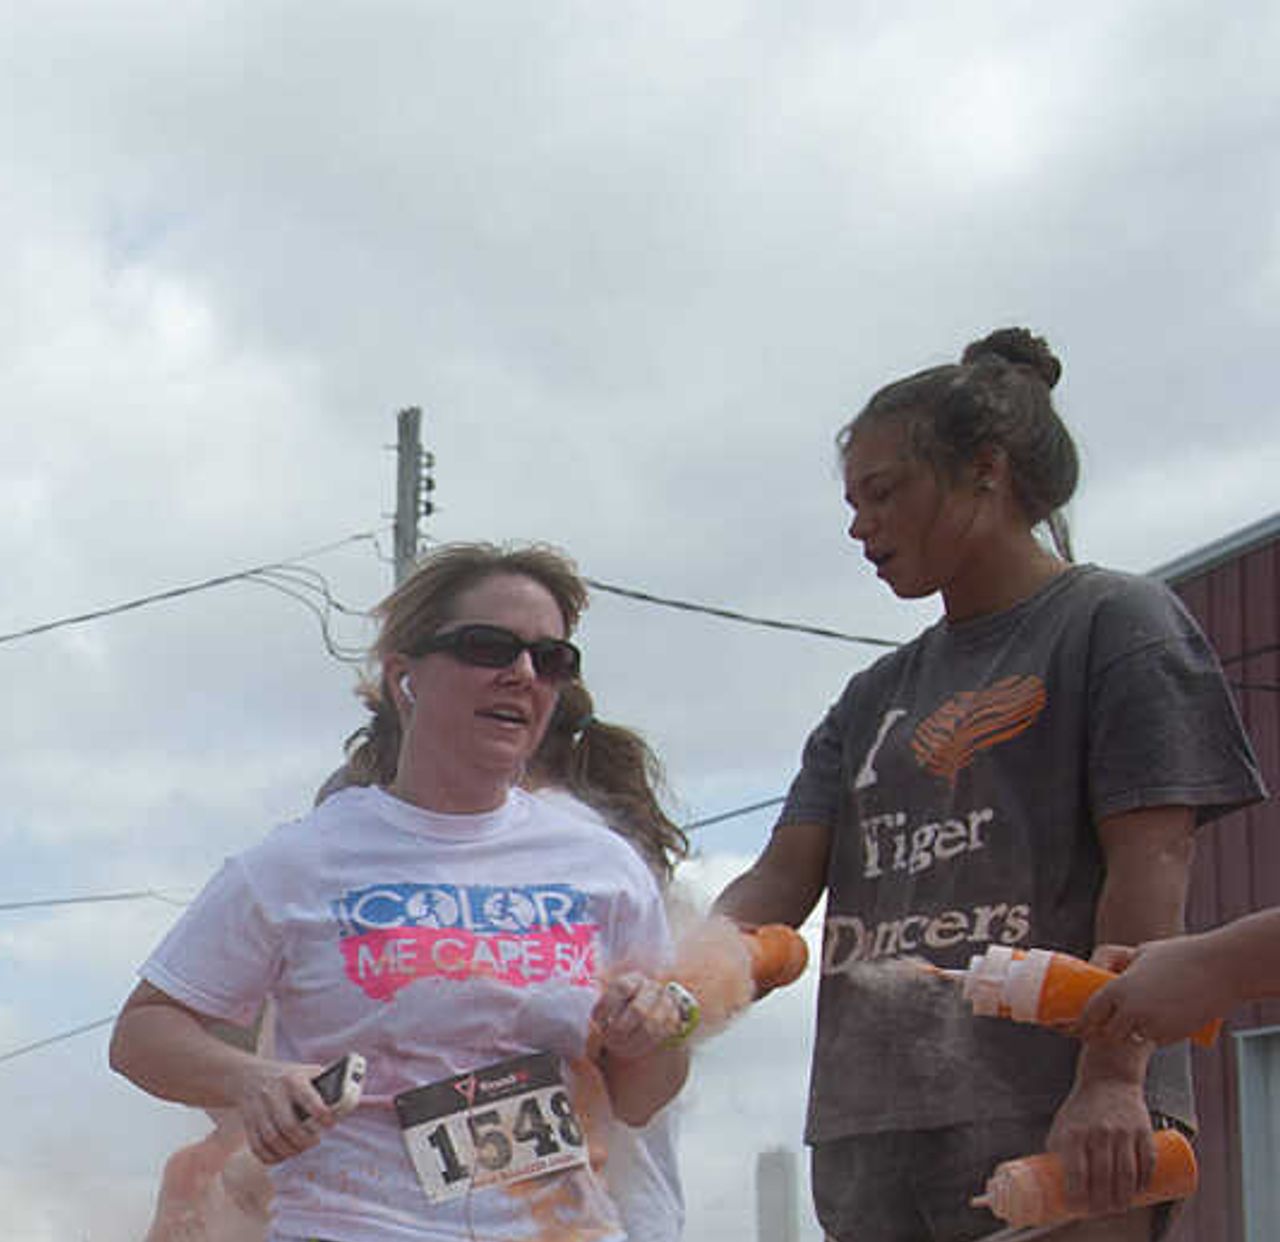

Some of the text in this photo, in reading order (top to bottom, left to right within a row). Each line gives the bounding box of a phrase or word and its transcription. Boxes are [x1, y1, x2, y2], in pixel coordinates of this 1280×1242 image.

[860, 808, 994, 879] Tiger
[352, 888, 576, 934] COLOR
[823, 902, 1031, 975] Dncers
[356, 938, 417, 980] ME
[431, 938, 542, 980] CAPE
[427, 1090, 584, 1185] 1548
